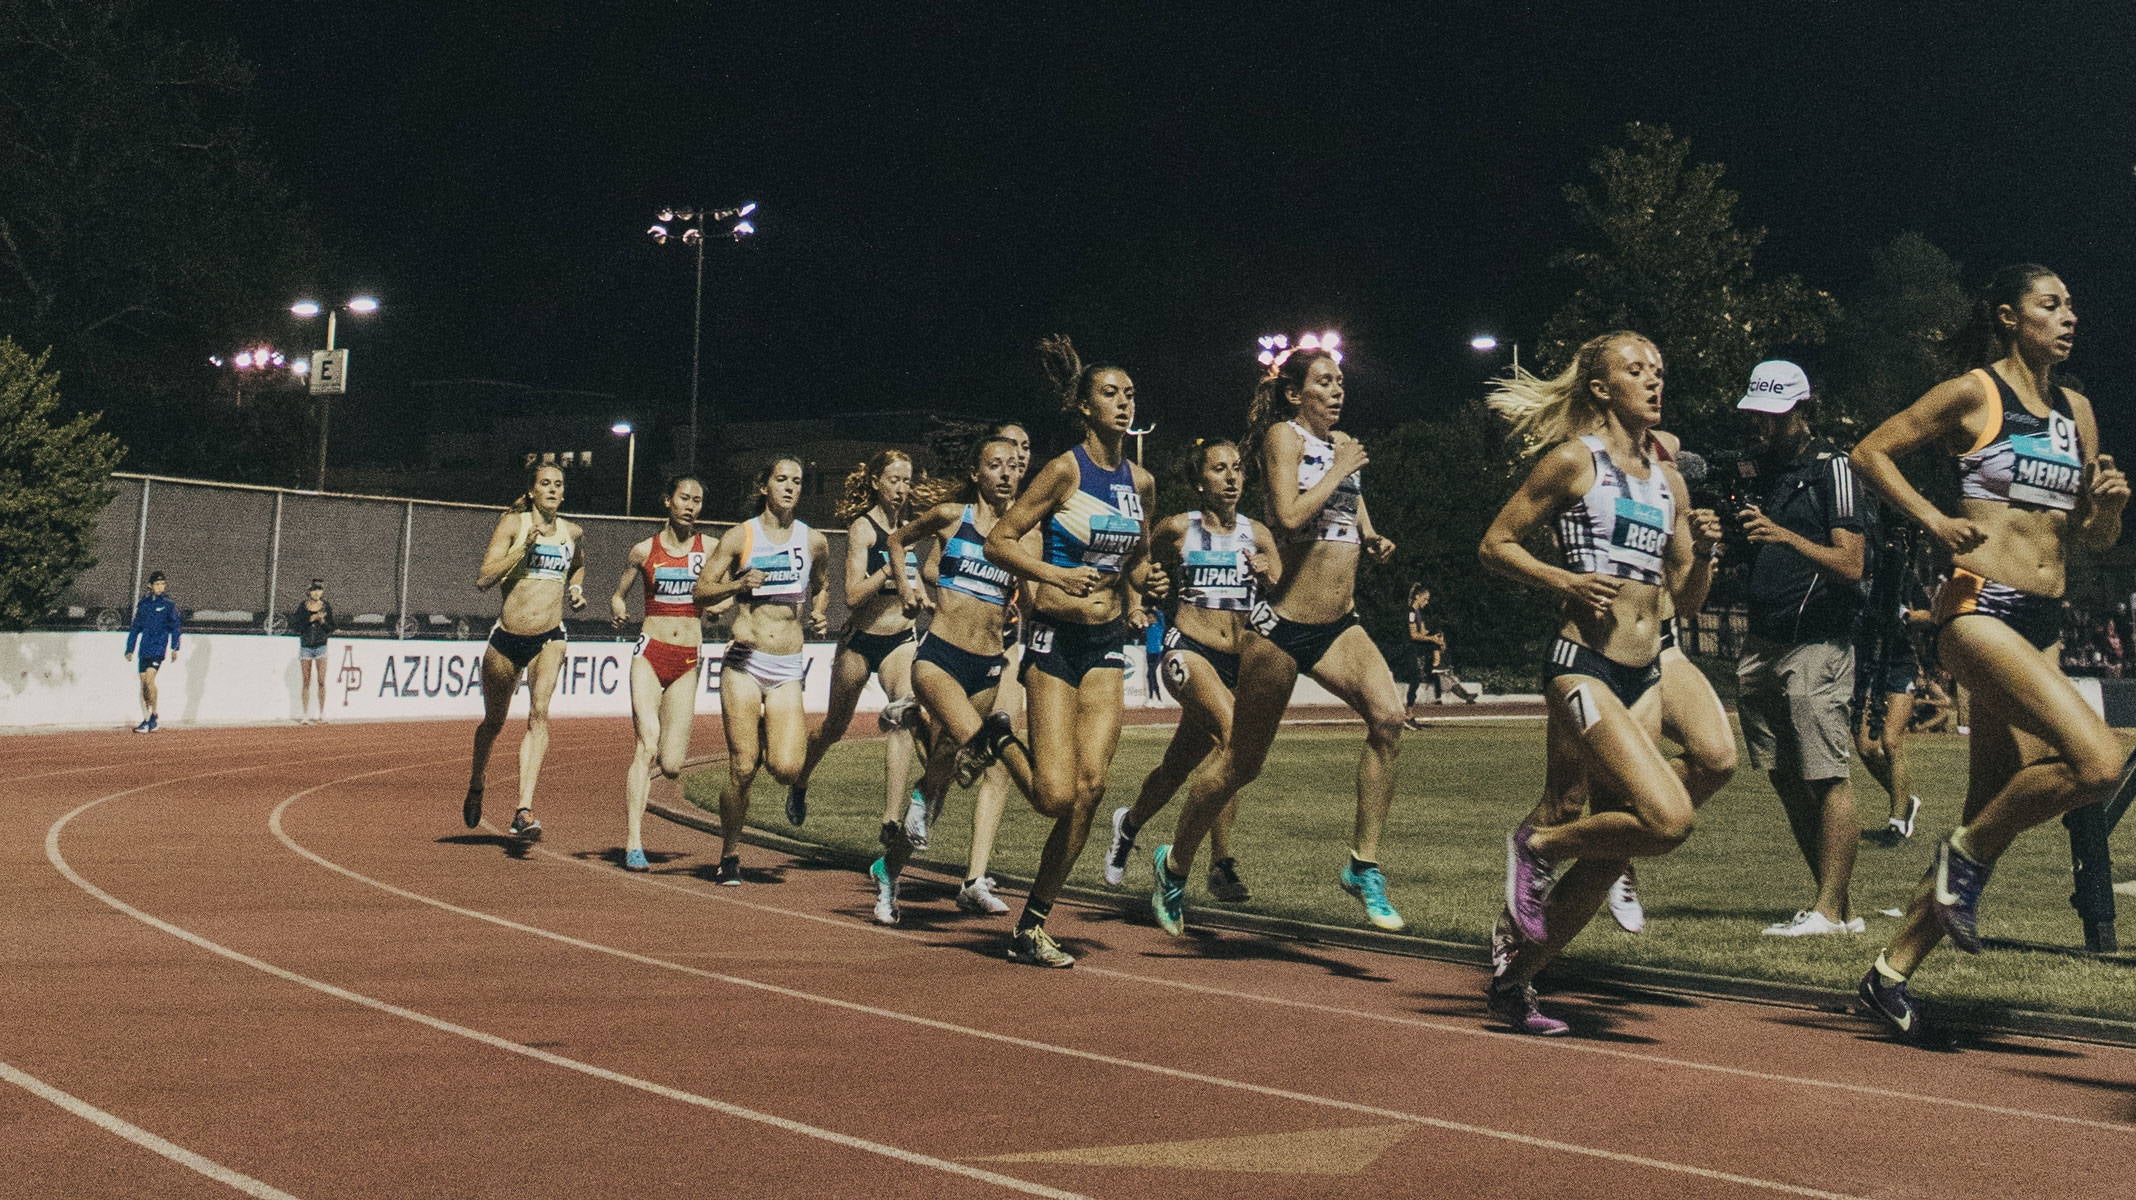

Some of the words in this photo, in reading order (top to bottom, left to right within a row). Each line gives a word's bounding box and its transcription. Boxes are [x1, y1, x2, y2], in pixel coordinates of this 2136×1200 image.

[322, 360, 333, 380] E
[1750, 378, 1784, 394] ciele
[2056, 417, 2071, 452] 9
[1123, 493, 1141, 518] 14
[692, 554, 703, 575] 8
[793, 547, 804, 570] 5
[1193, 567, 1241, 585] LIPAR
[378, 655, 483, 698] AZUSA
[1168, 658, 1185, 687] 3
